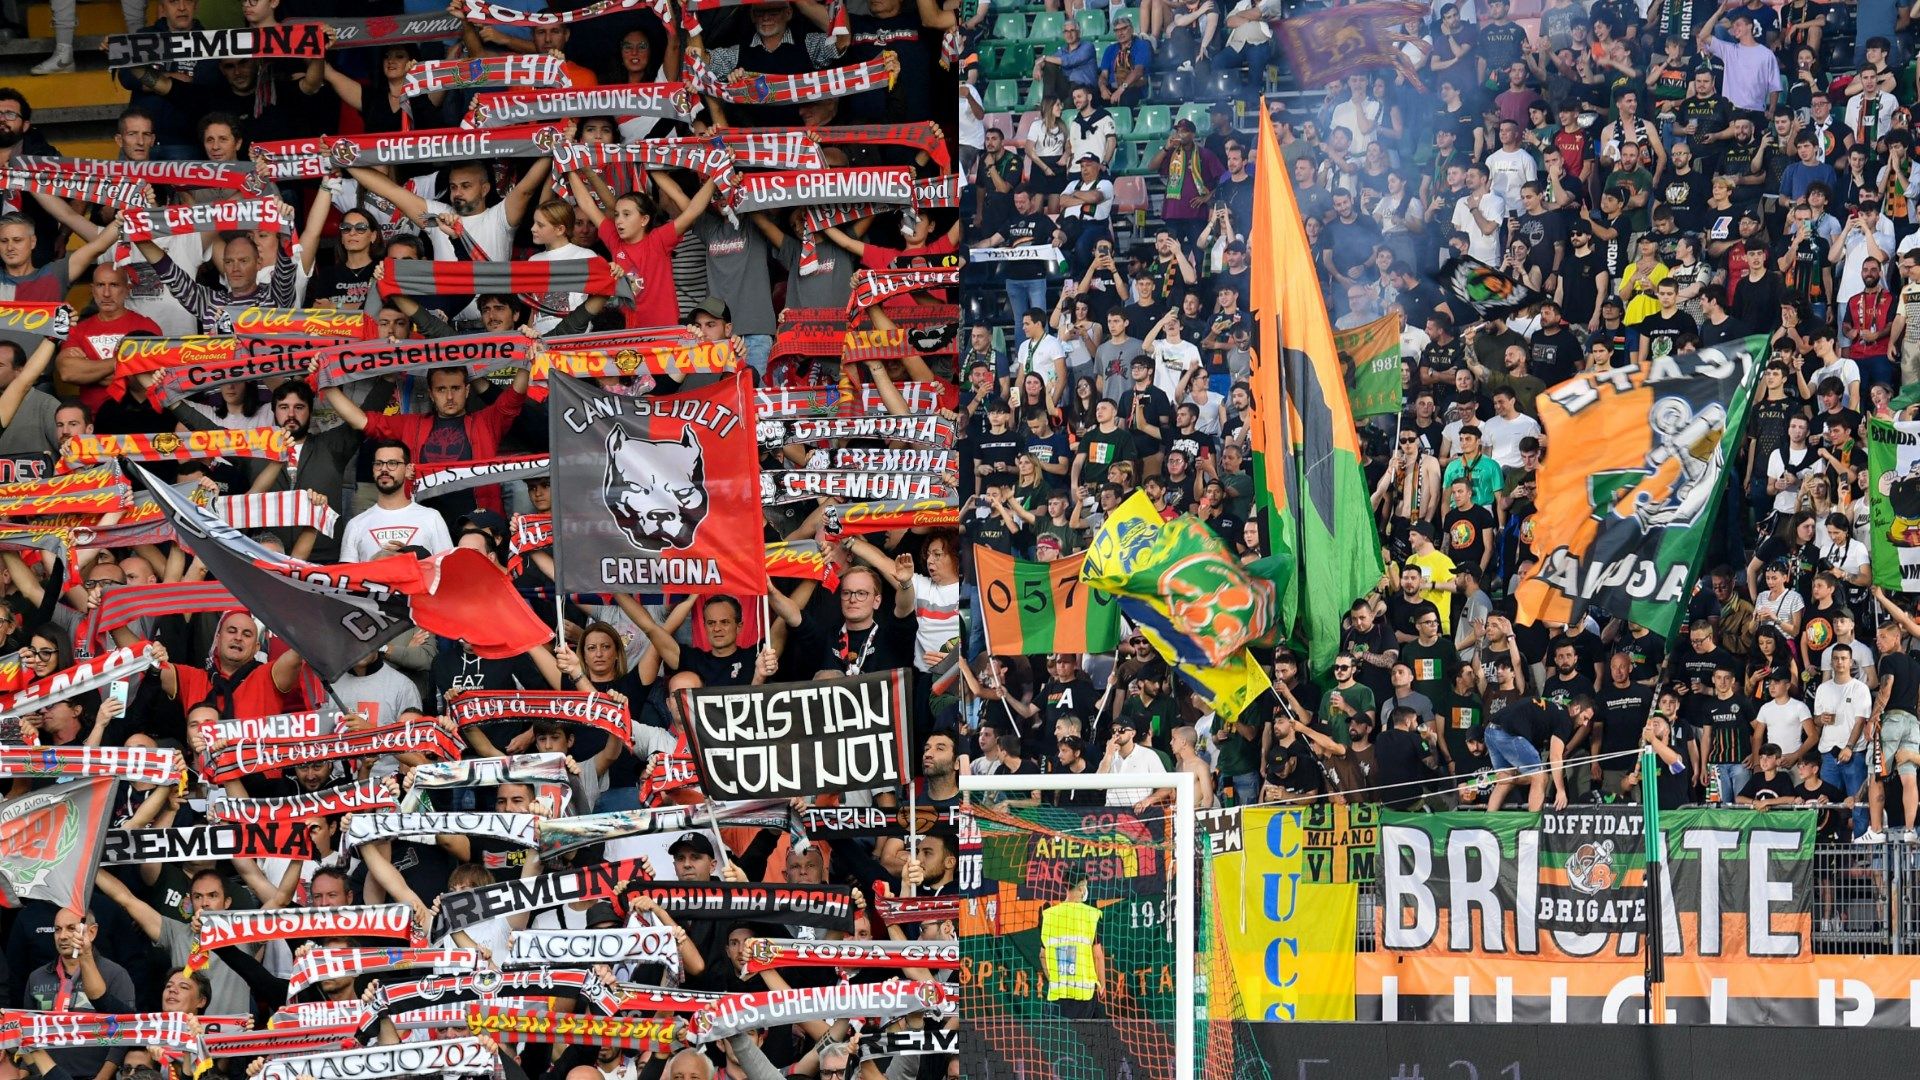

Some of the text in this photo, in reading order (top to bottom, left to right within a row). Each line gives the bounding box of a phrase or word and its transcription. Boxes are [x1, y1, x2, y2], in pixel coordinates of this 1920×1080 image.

[493, 85, 662, 121] U.S. CREMONESE
[376, 137, 416, 163] CHE
[417, 134, 477, 160] BELLO
[752, 176, 792, 203] U.S.
[238, 307, 364, 328] Old Red
[118, 335, 238, 363] Old Red
[338, 341, 515, 375] Castelleone
[1371, 353, 1400, 374] 1987
[563, 397, 740, 439] CANI SCIOLTI
[794, 418, 938, 444] CREMONA
[834, 448, 947, 472] CREMONA
[783, 473, 932, 500] CREMONA
[376, 528, 410, 541] GUESS
[601, 557, 722, 585] CREMONA
[452, 673, 485, 688] EA7
[697, 679, 892, 743] CRISTIAN
[1712, 713, 1738, 721] VENEZIA
[81, 745, 170, 784] 1903
[238, 737, 284, 774] Chi
[704, 731, 898, 795] CON NOI
[1307, 829, 1374, 847] MILANO
[1543, 813, 1646, 837] DIFFIDAT
[1308, 853, 1376, 882] V M
[730, 888, 768, 912] MA
[773, 888, 849, 917] POCHI
[1539, 897, 1646, 924] BRIGATE
[793, 941, 888, 962] TODA
[720, 994, 766, 1029] U.S.
[767, 981, 908, 1016] CREMONESE
